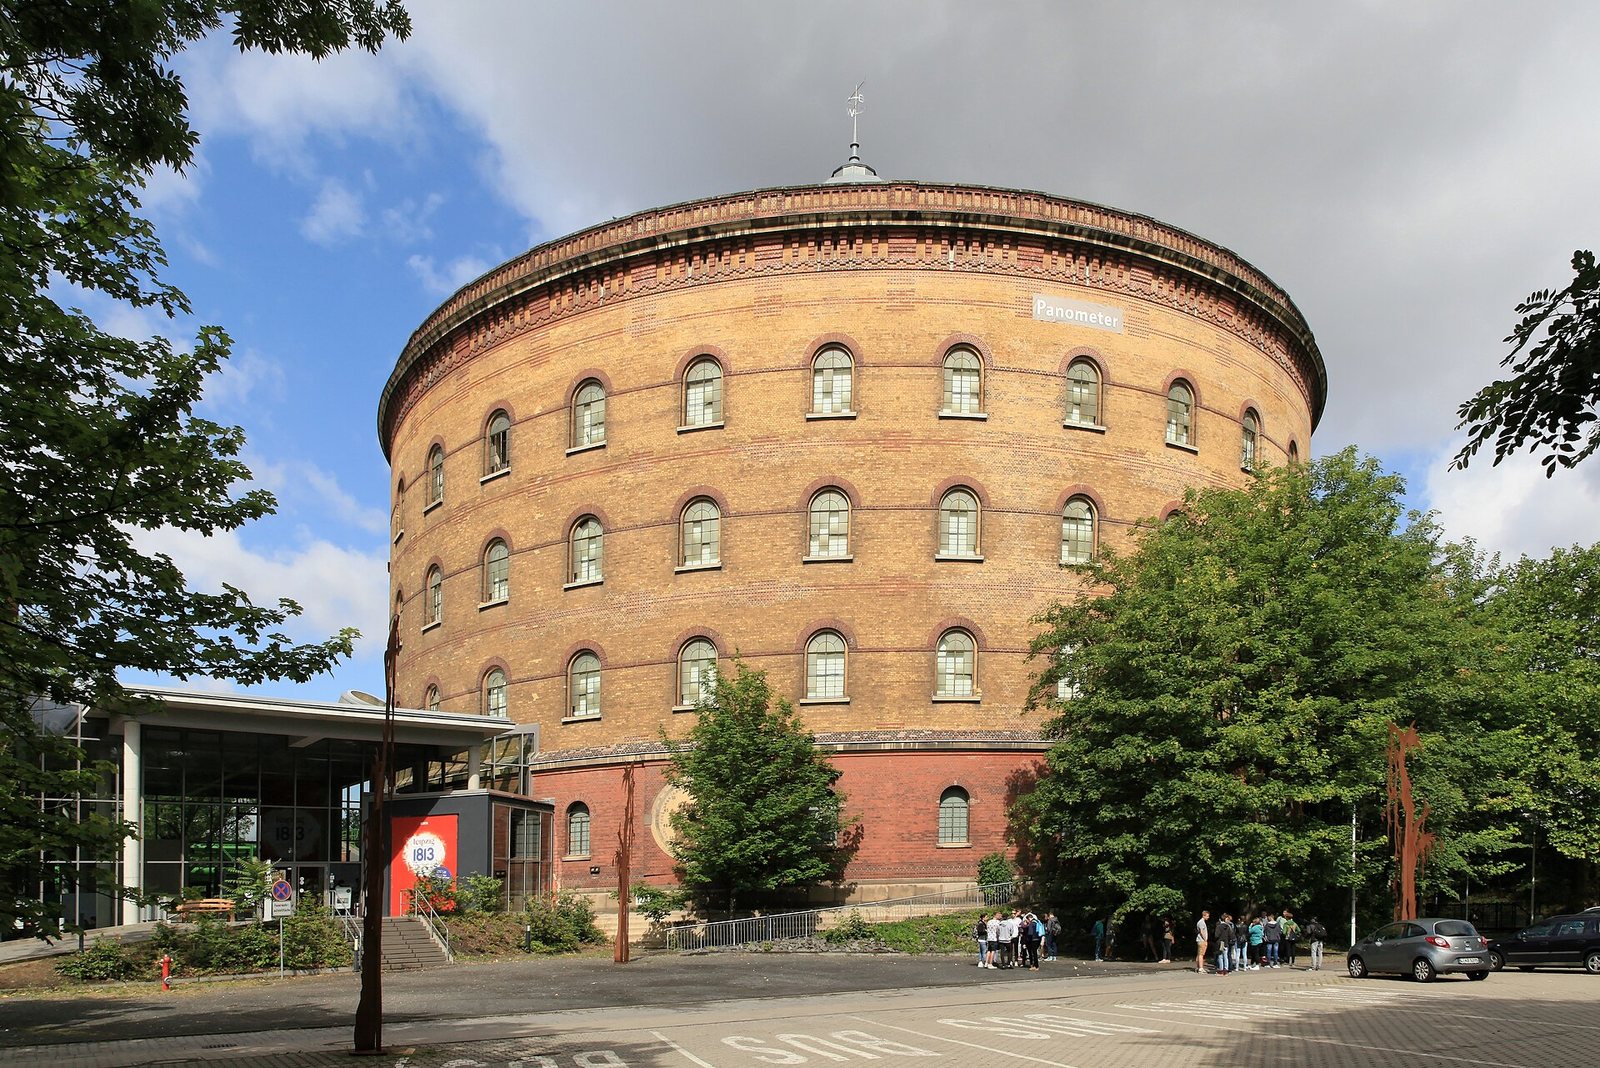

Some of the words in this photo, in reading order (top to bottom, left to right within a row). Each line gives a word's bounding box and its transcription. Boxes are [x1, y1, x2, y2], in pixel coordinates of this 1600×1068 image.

[1037, 299, 1119, 328] Panometer
[276, 826, 305, 841] 183
[413, 847, 435, 861] 1813
[937, 1013, 1163, 1040] BUS
[720, 1029, 942, 1064] BUS
